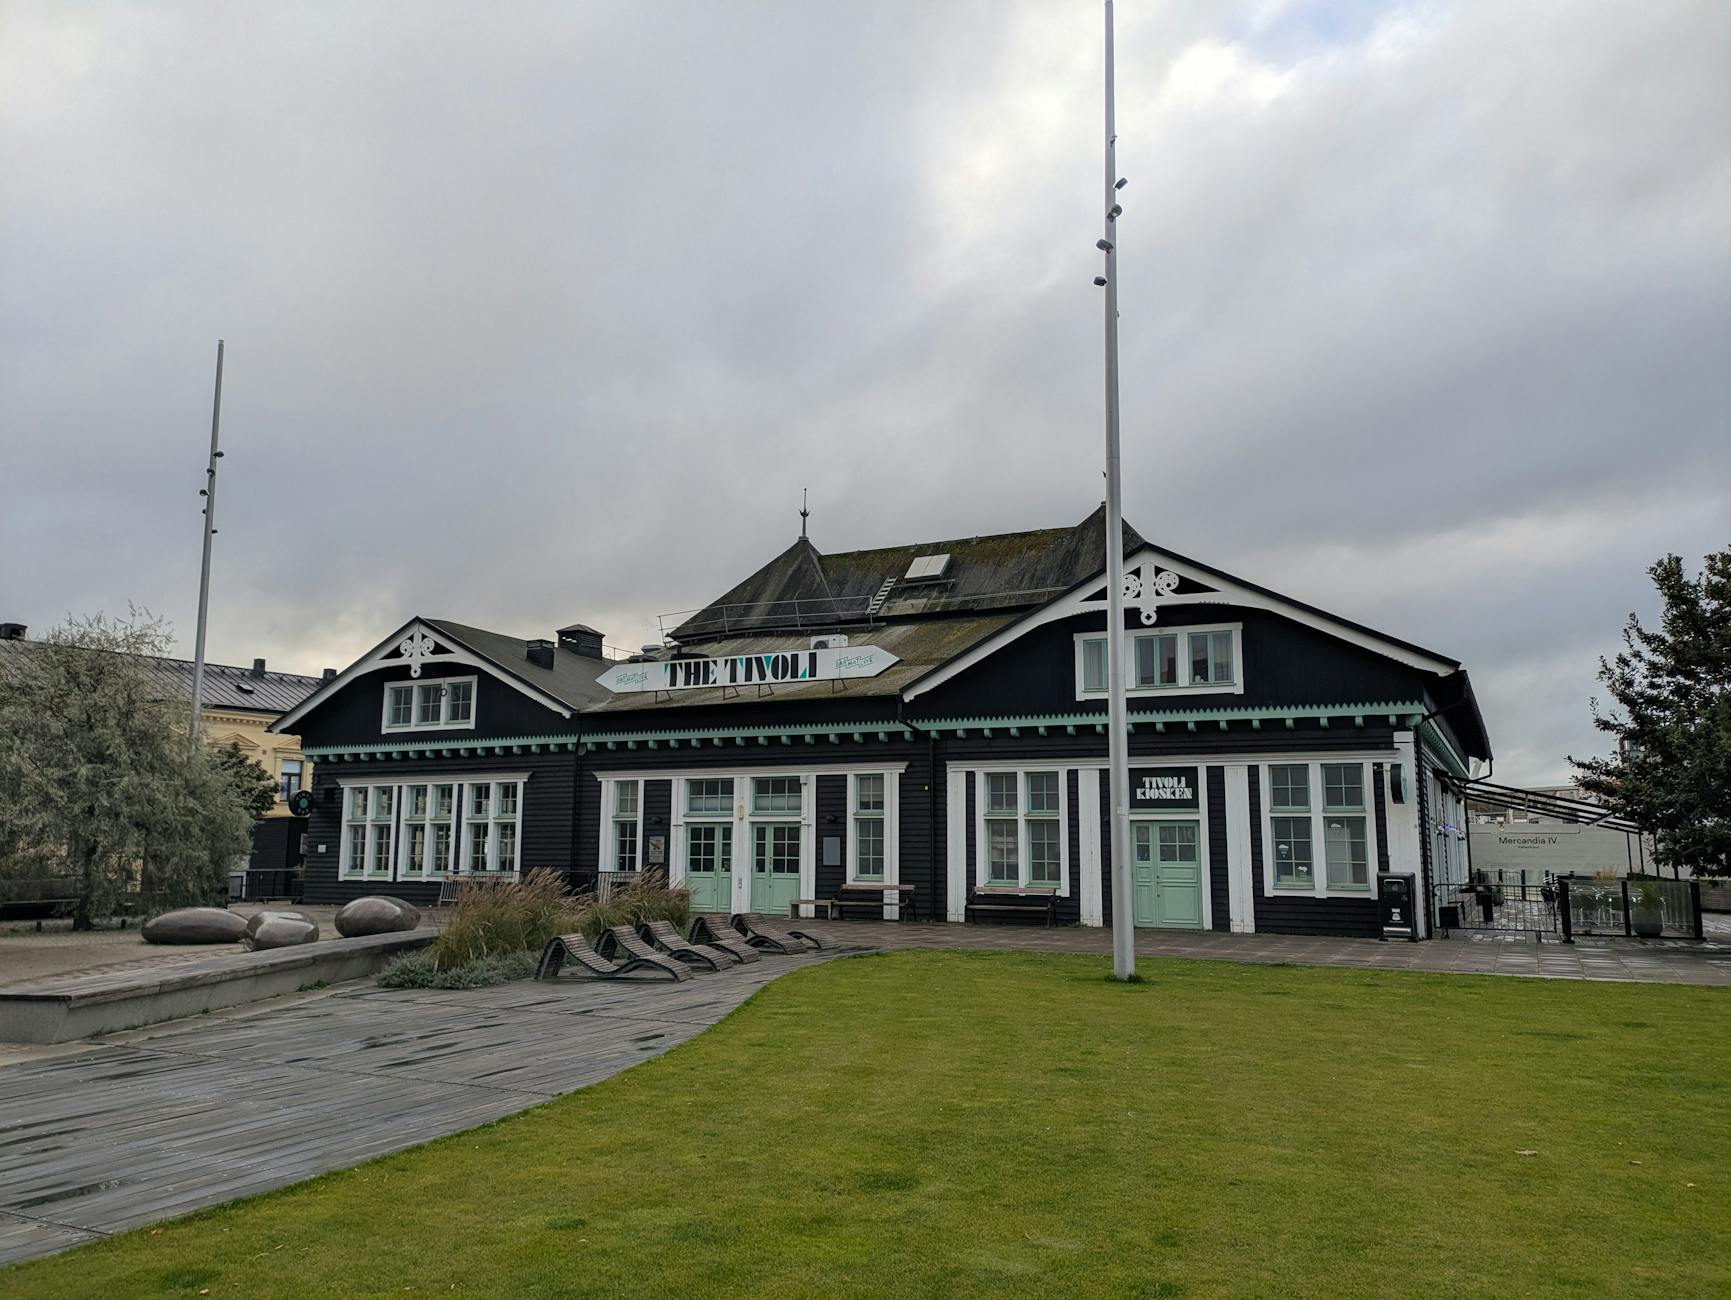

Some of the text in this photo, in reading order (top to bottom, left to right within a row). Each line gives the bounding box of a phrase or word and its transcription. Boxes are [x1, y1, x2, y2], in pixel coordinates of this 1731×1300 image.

[664, 660, 717, 687] THE
[724, 652, 817, 683] TIVOLI
[1142, 776, 1186, 788] TIVOLI
[1136, 787, 1193, 800] KIOSKEN
[1498, 836, 1558, 845] Mercandia IV
